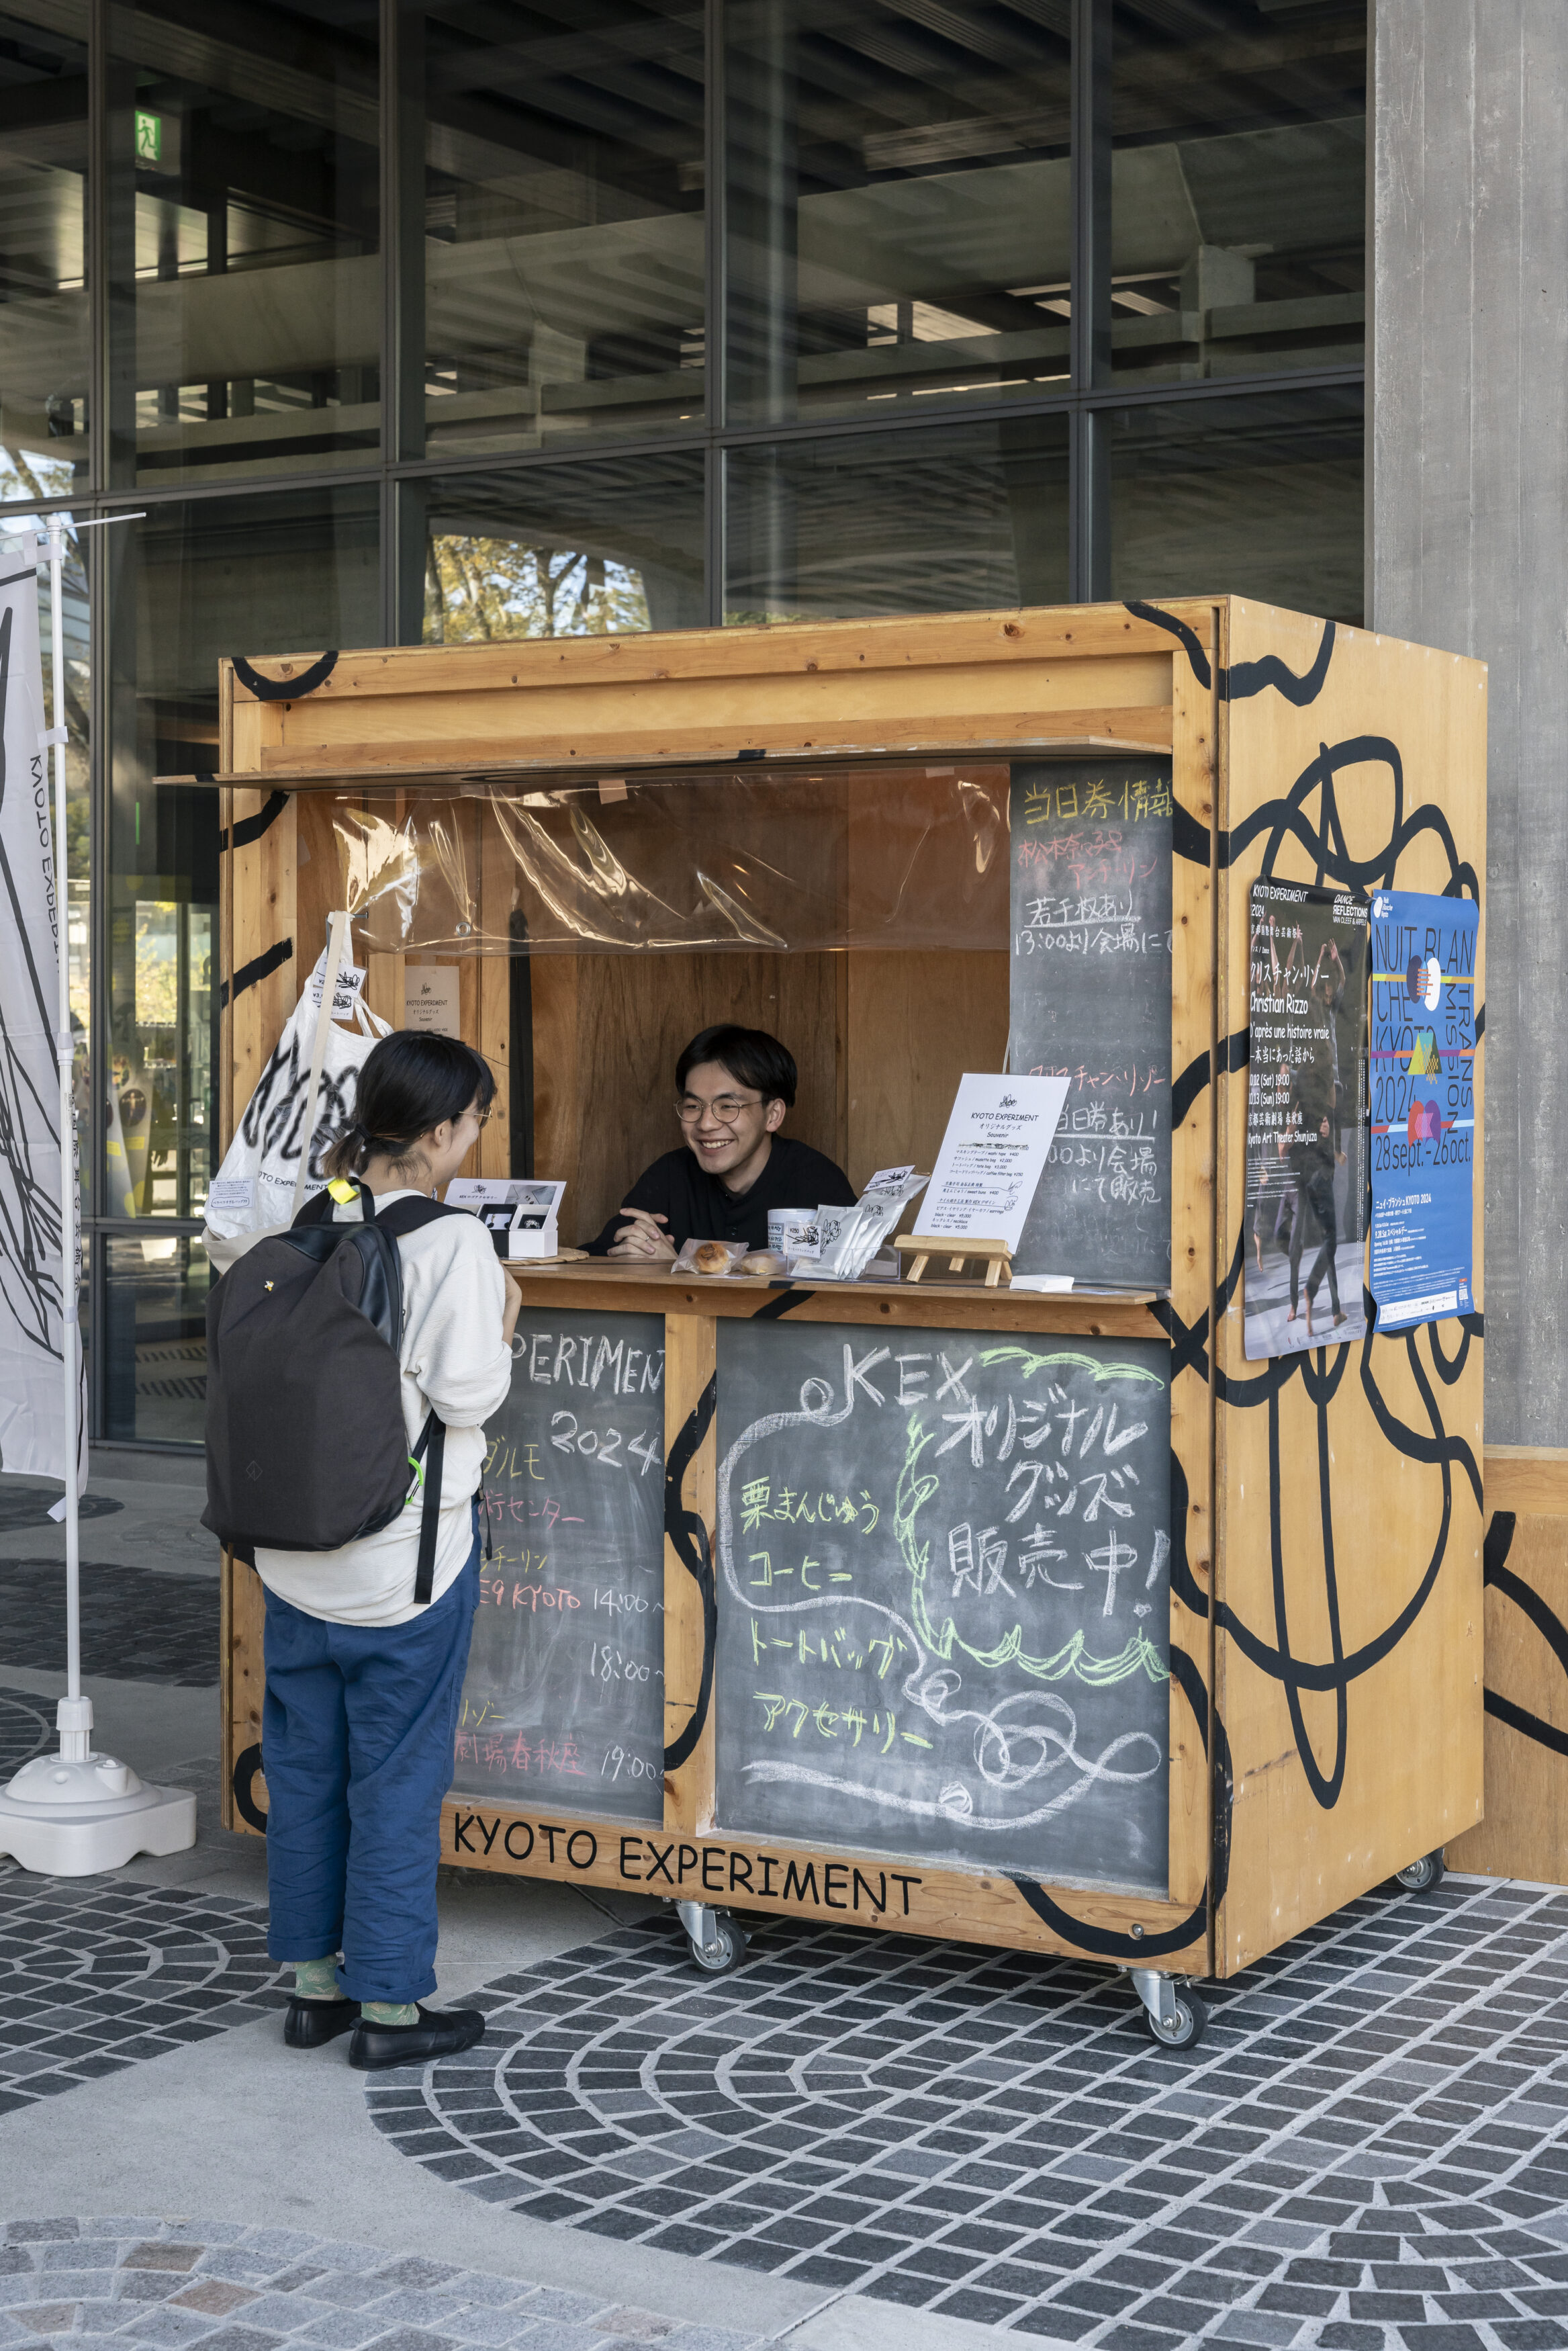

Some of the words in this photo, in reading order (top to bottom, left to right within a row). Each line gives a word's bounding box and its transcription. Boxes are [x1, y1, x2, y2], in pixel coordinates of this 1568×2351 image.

[1270, 887, 1309, 903] EXPERIMENT
[1334, 894, 1355, 905] DANCE
[1251, 903, 1264, 917] 2024
[1340, 916, 1352, 924] CLEEF
[1356, 918, 1367, 926] ARPELS
[1375, 924, 1418, 972] NUIT
[1424, 928, 1473, 974] BLAN
[1250, 961, 1330, 987] クリスチャン・リゾー
[1250, 990, 1285, 1014] Christian
[1286, 993, 1308, 1014] Rizzo
[1250, 1021, 1273, 1043] D'après
[1274, 1027, 1285, 1038] une
[1287, 1022, 1312, 1039] histoire
[1313, 1025, 1330, 1040] vraie
[1260, 1073, 1275, 1089] (Sat)
[1275, 1073, 1290, 1086] 19:00
[1260, 1092, 1275, 1107] (Sun)
[1275, 1092, 1290, 1104] 19:00
[995, 1113, 1040, 1121] EXPERIMENT
[1248, 1132, 1261, 1148] Kyoto
[1262, 1132, 1273, 1144] Art
[1273, 1130, 1293, 1143] Theater
[1294, 1130, 1318, 1146] Shunjuza
[1073, 1177, 1161, 1206] にて販売
[1420, 1193, 1432, 1204] 2024
[844, 1343, 974, 1407] KEX
[935, 1384, 1148, 1468] オリジナル
[551, 1410, 662, 1476] 2024
[1005, 1460, 1140, 1523] グッズ
[740, 1476, 879, 1535] 栗まんじゅう
[748, 1551, 853, 1591] コーヒー
[512, 1581, 581, 1613] KYOTO
[751, 1617, 908, 1679] トートバッグ
[752, 1691, 933, 1754] アクセサリー
[454, 1812, 598, 1870] KYOTO
[619, 1836, 923, 1916] EXPERIMENT
